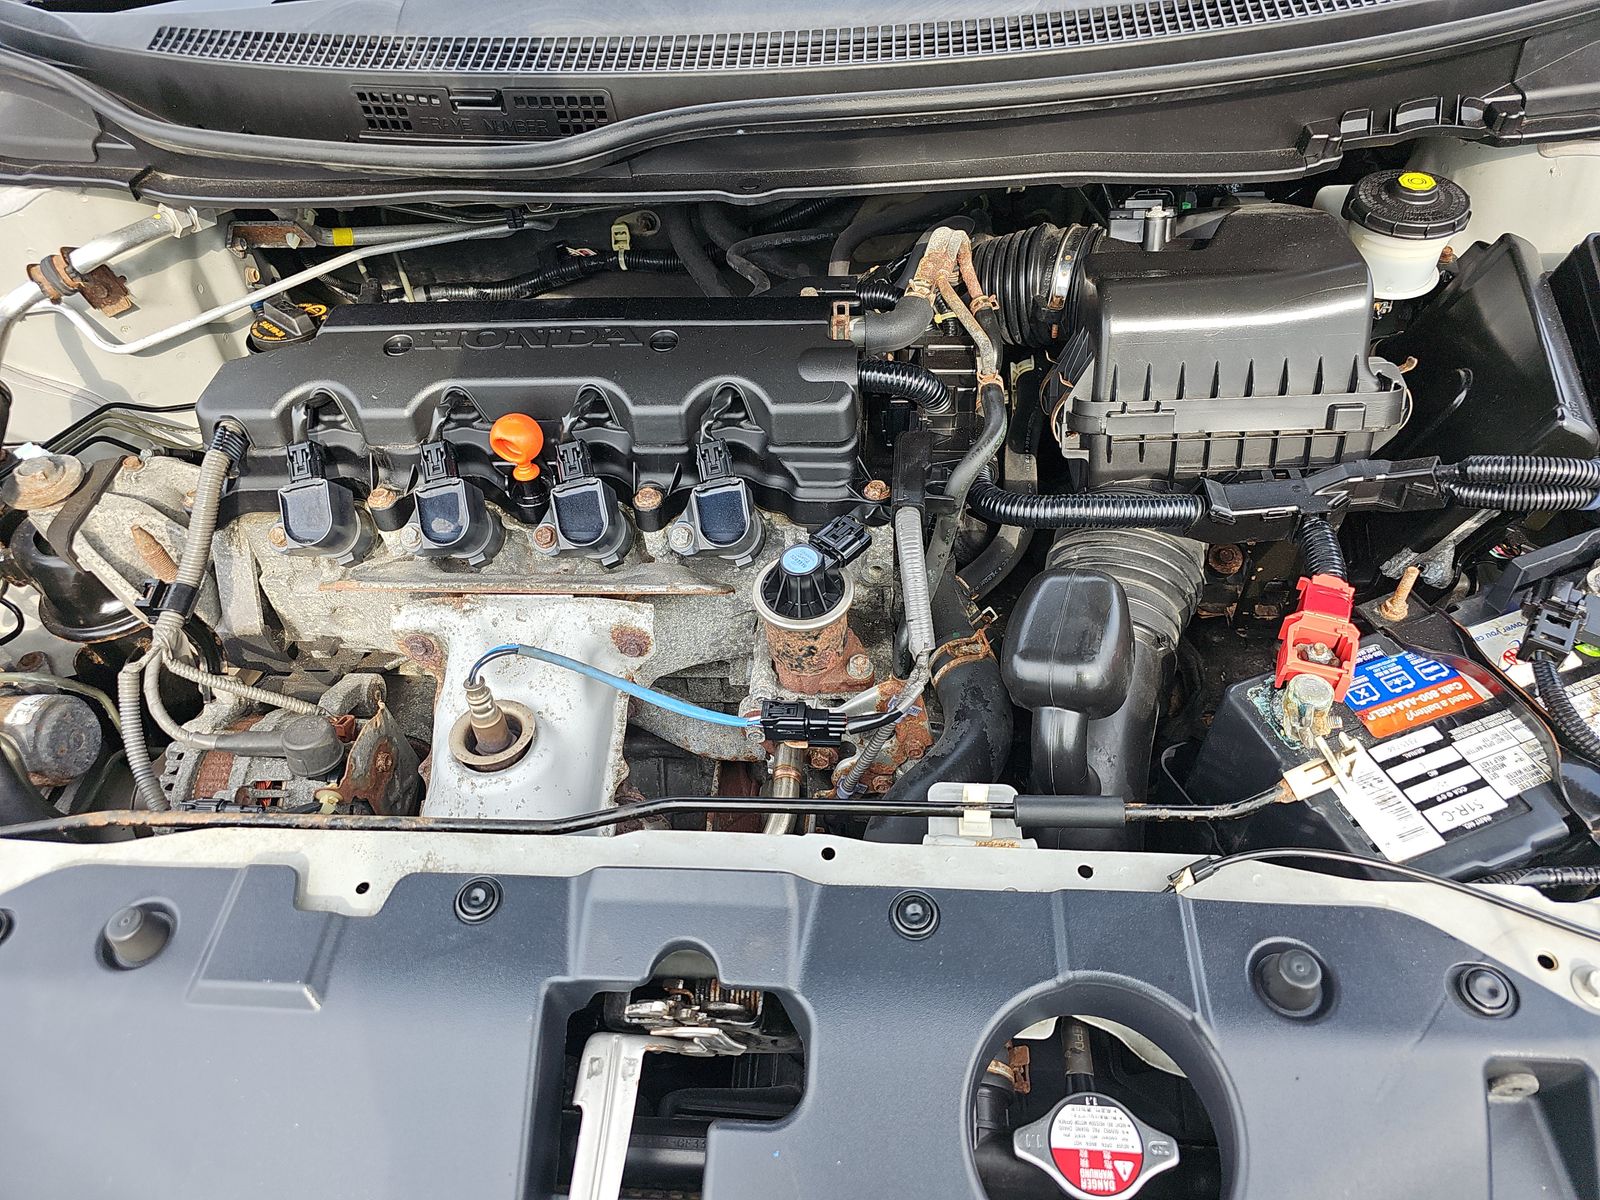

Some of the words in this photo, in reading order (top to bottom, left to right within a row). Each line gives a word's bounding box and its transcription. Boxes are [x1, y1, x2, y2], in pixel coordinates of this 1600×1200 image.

[419, 116, 474, 132] FRAME
[482, 118, 549, 133] NUMBER
[414, 327, 644, 350] HONDA
[1484, 627, 1501, 638] you
[1438, 681, 1461, 692] Call:
[1448, 693, 1472, 705] Need
[1404, 702, 1443, 721] battery?
[1401, 747, 1425, 758] SERIAL
[1490, 754, 1506, 763] HELP
[1482, 762, 1507, 774] MEDICAL
[1520, 763, 1537, 772] WITH
[1503, 768, 1522, 779] WATER
[1452, 785, 1468, 795] CCA
[1440, 798, 1484, 822] 51R-C
[1474, 814, 1492, 825] PART
[1079, 1167, 1114, 1179] WARNUNG
[1080, 1178, 1115, 1191] DANGER
